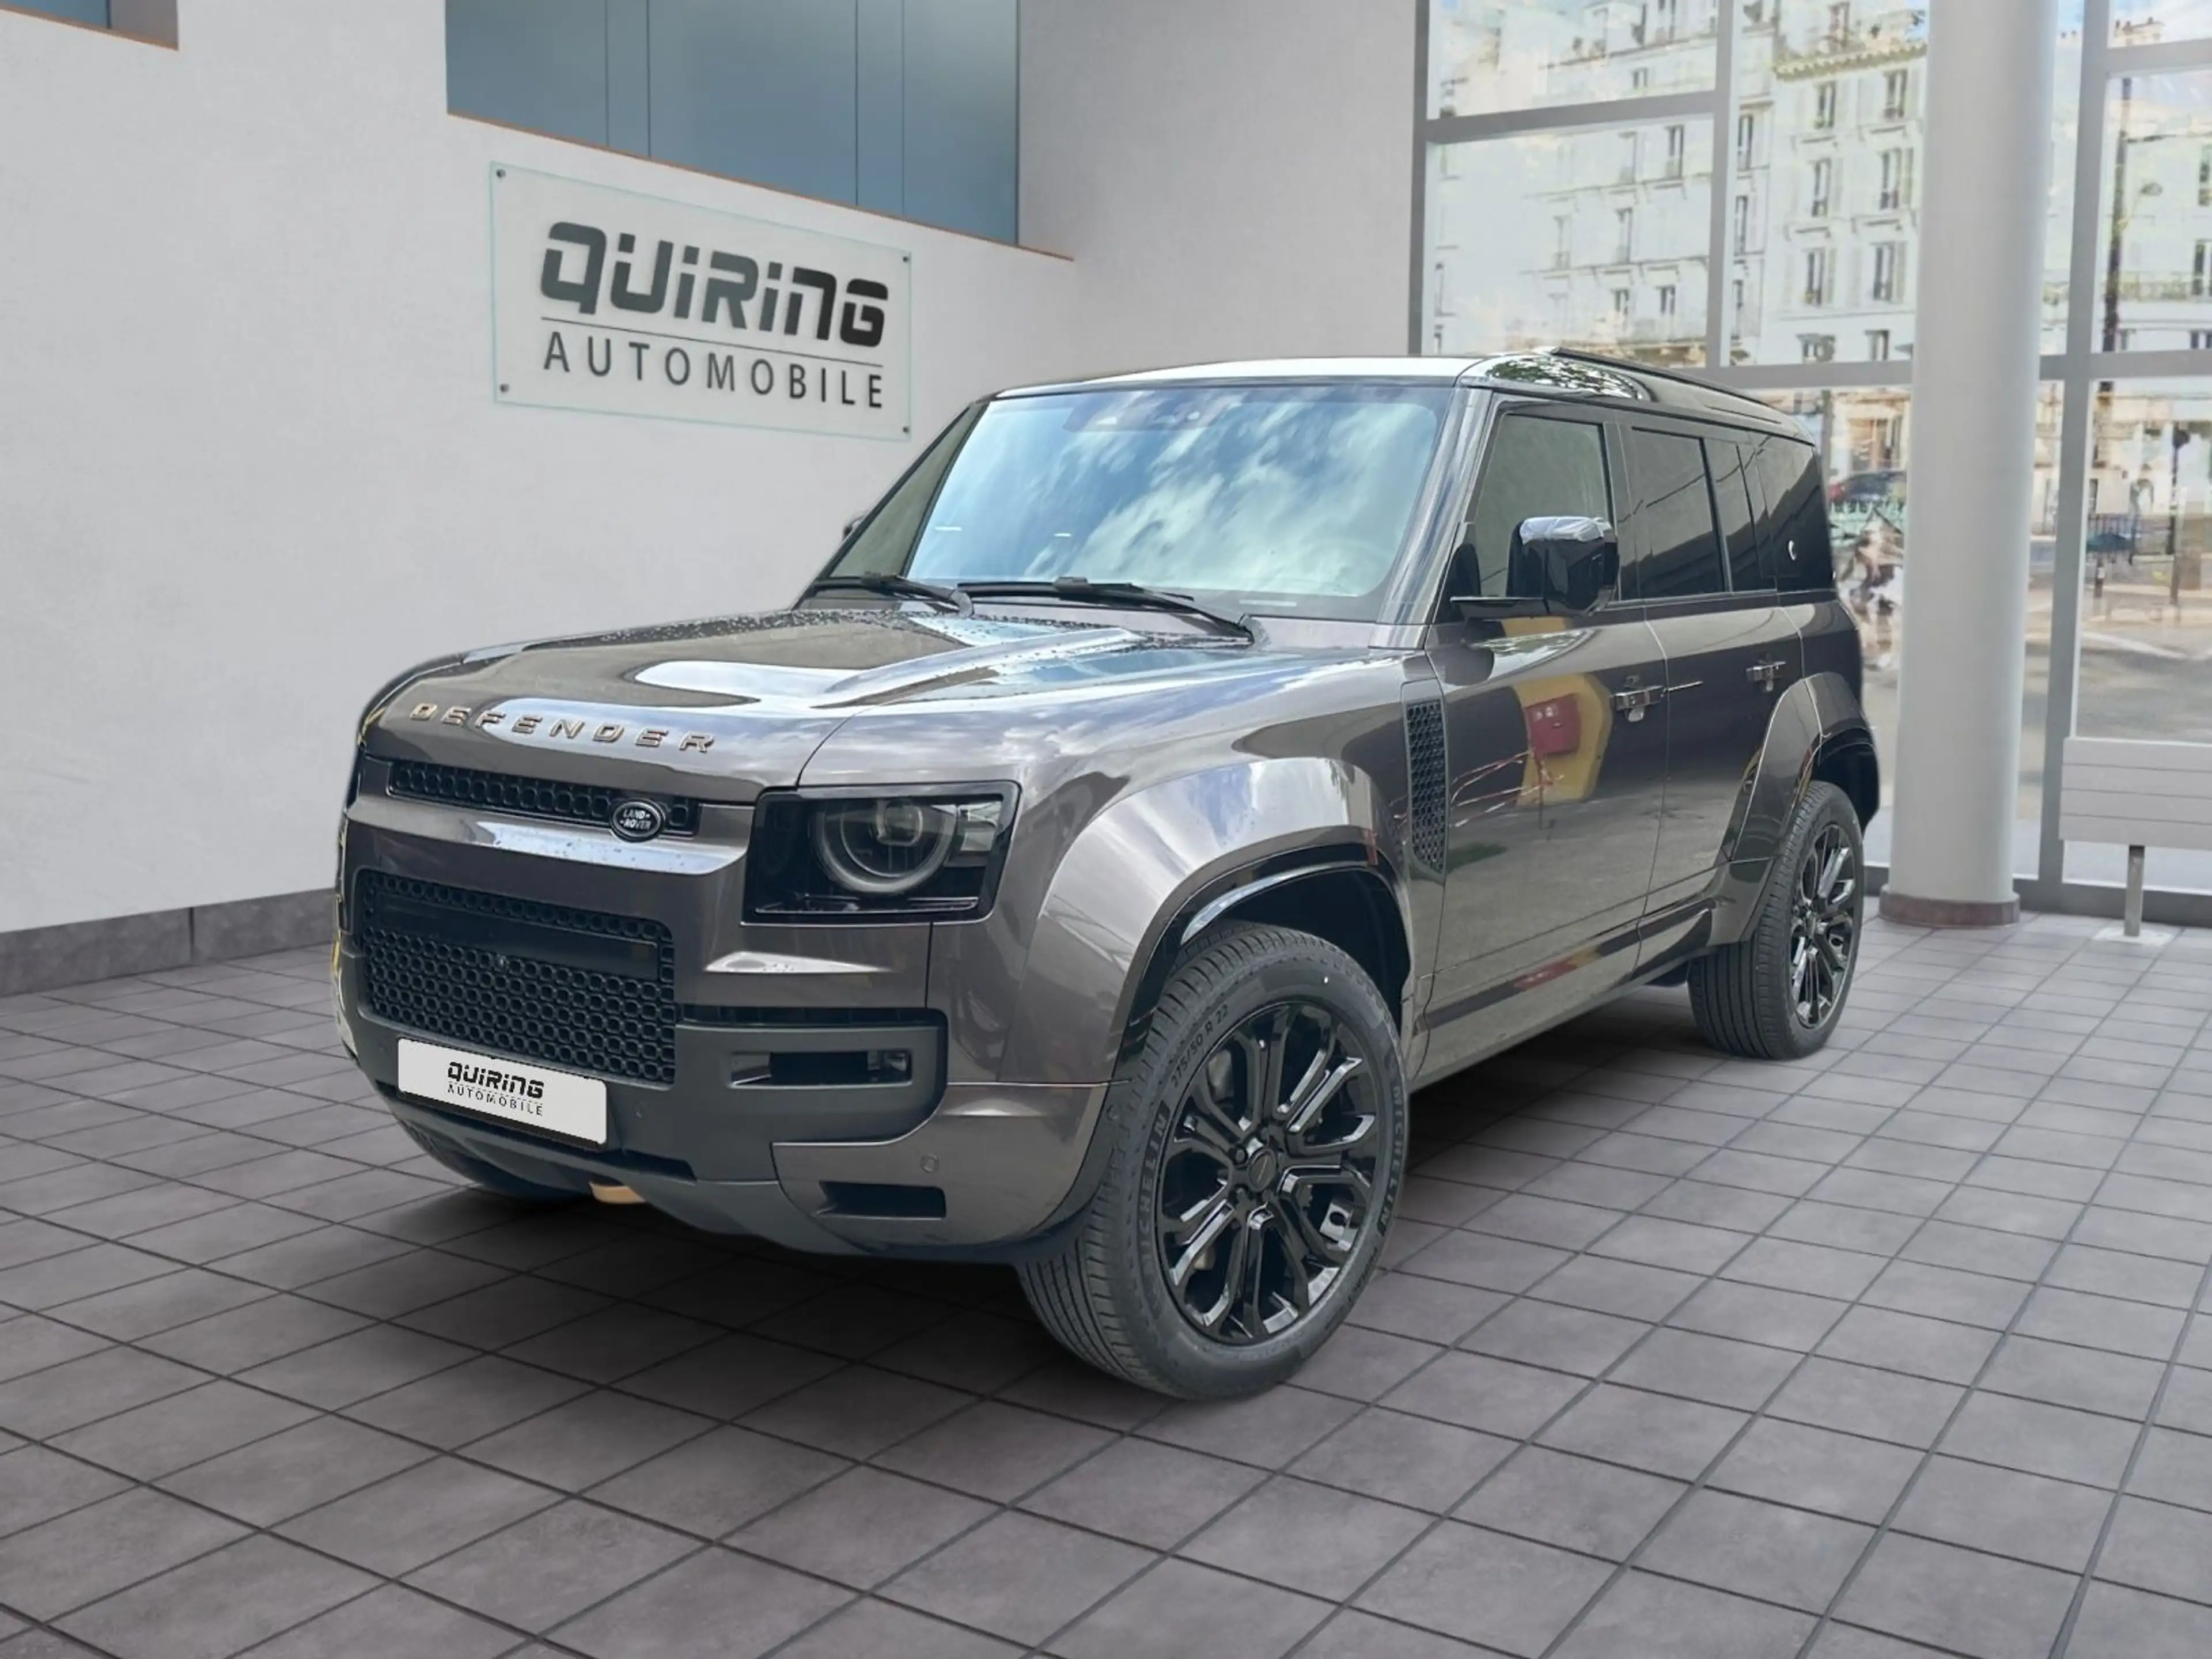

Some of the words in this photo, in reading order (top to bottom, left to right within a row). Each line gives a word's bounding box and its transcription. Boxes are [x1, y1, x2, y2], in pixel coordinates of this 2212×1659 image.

[544, 331, 882, 408] AUTOMOBILE
[409, 703, 715, 753] DEFENDER
[623, 808, 646, 819] LAND
[623, 818, 652, 830] ROVER
[448, 1084, 543, 1116] AUTOMOBILE
